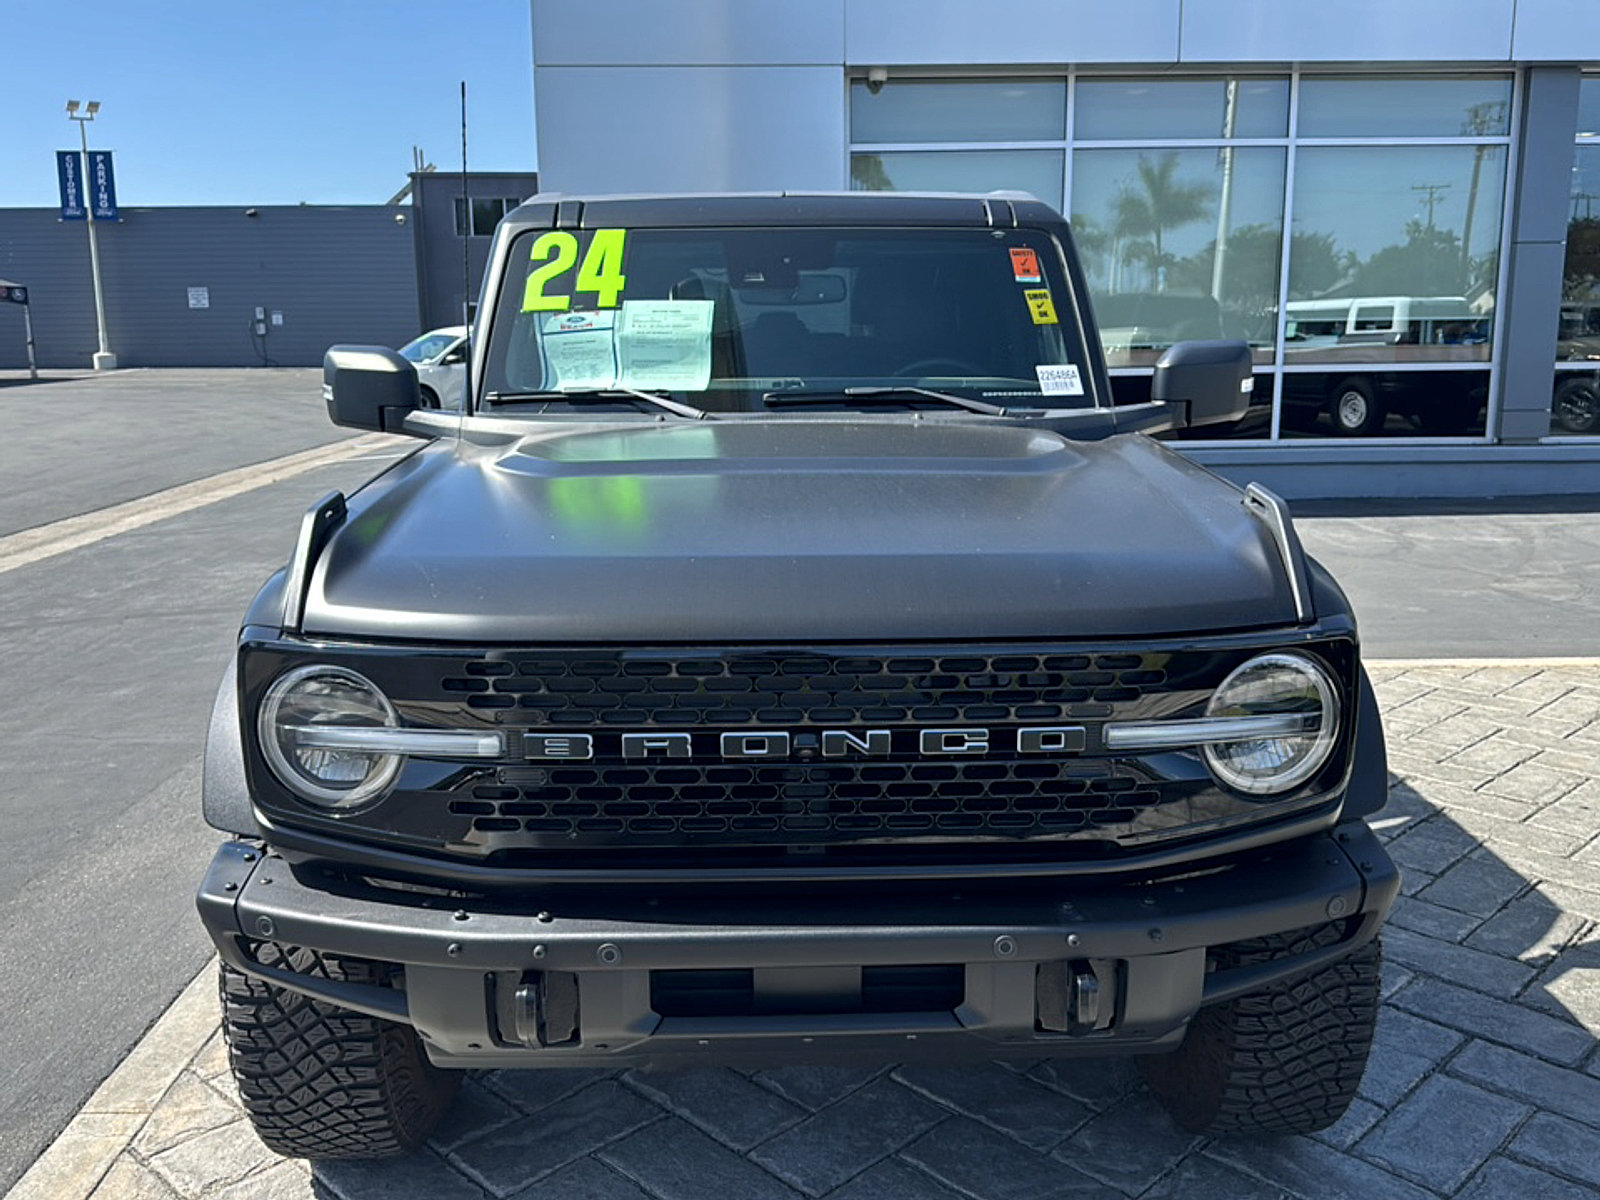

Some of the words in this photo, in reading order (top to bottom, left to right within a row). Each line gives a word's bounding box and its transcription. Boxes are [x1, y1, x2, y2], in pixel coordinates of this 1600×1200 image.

[65, 154, 76, 208] CUSTOMER
[96, 154, 109, 208] PARKING
[522, 229, 627, 311] 24
[1027, 292, 1049, 301] SMOG
[523, 727, 1087, 760] BRONCO
